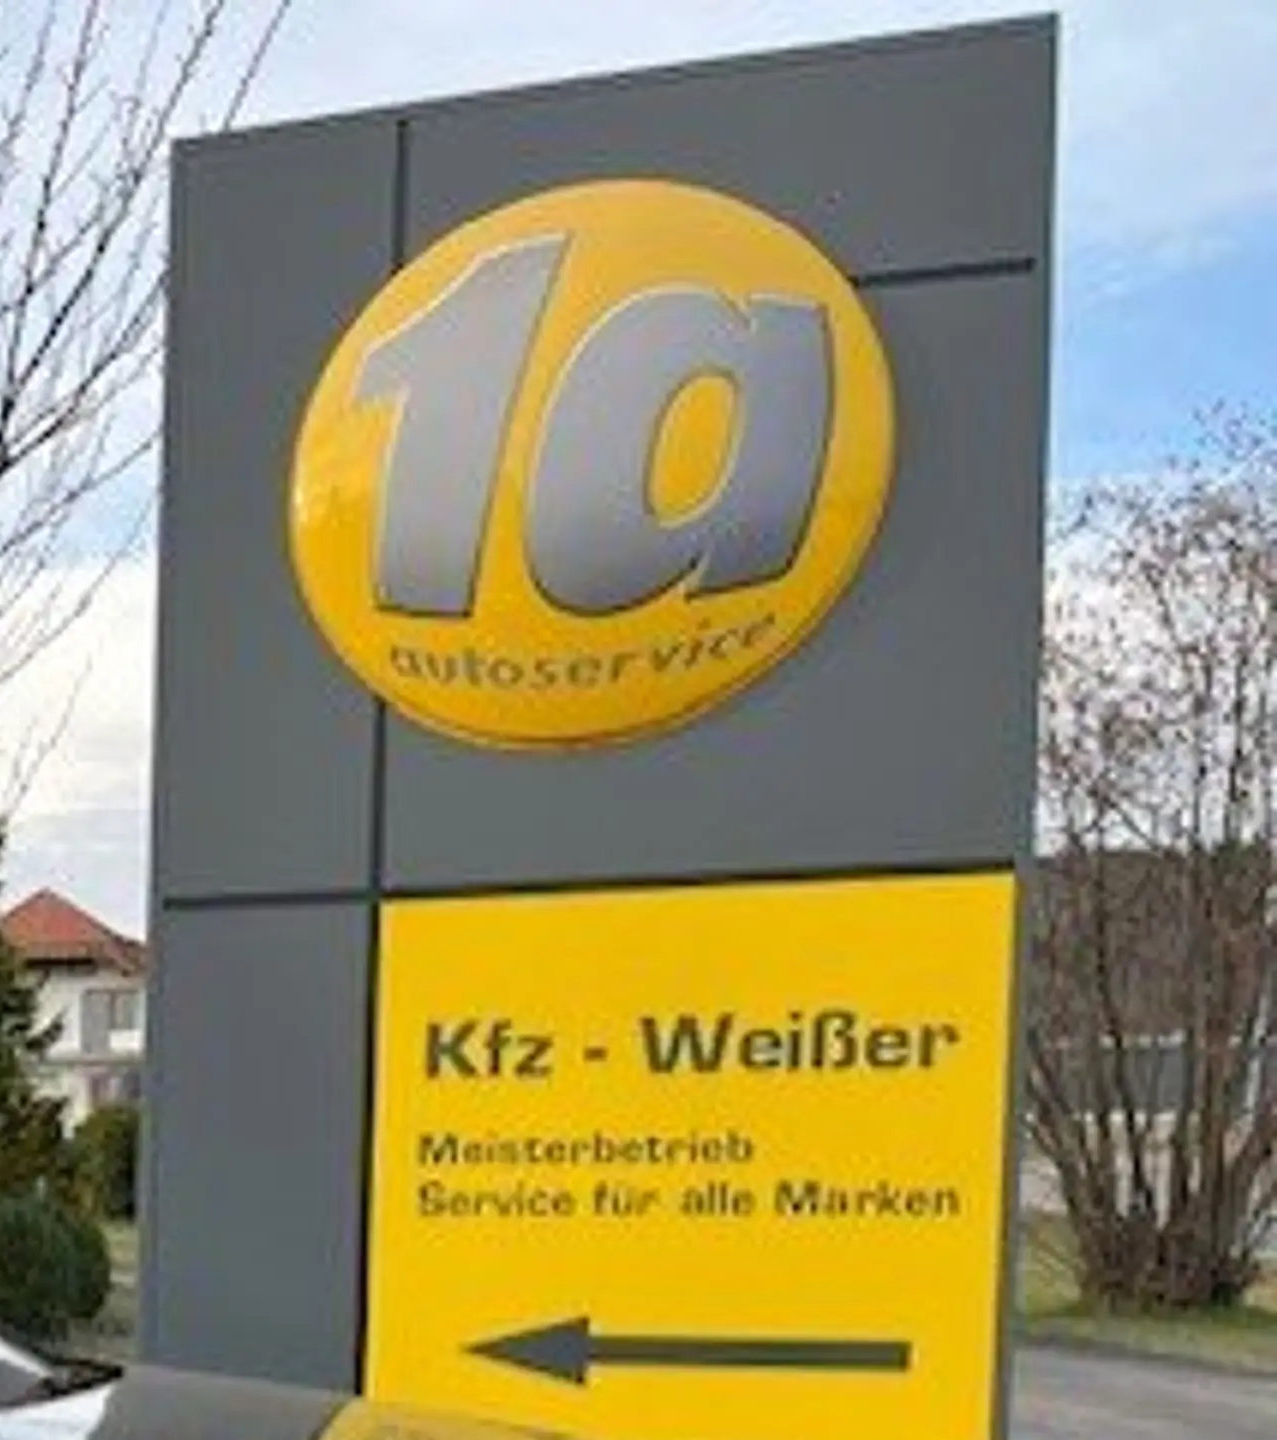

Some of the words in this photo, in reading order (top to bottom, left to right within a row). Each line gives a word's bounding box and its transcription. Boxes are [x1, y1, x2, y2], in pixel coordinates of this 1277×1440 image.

[349, 231, 836, 620] 1a
[389, 611, 777, 690] autoservice
[424, 1019, 554, 1080] Kfz
[638, 1008, 961, 1076] Weißer
[417, 1130, 755, 1166] Meisterbetrieb
[417, 1180, 576, 1218] Service
[592, 1181, 656, 1218] für
[680, 1181, 755, 1217] alle
[773, 1179, 960, 1219] Marken
